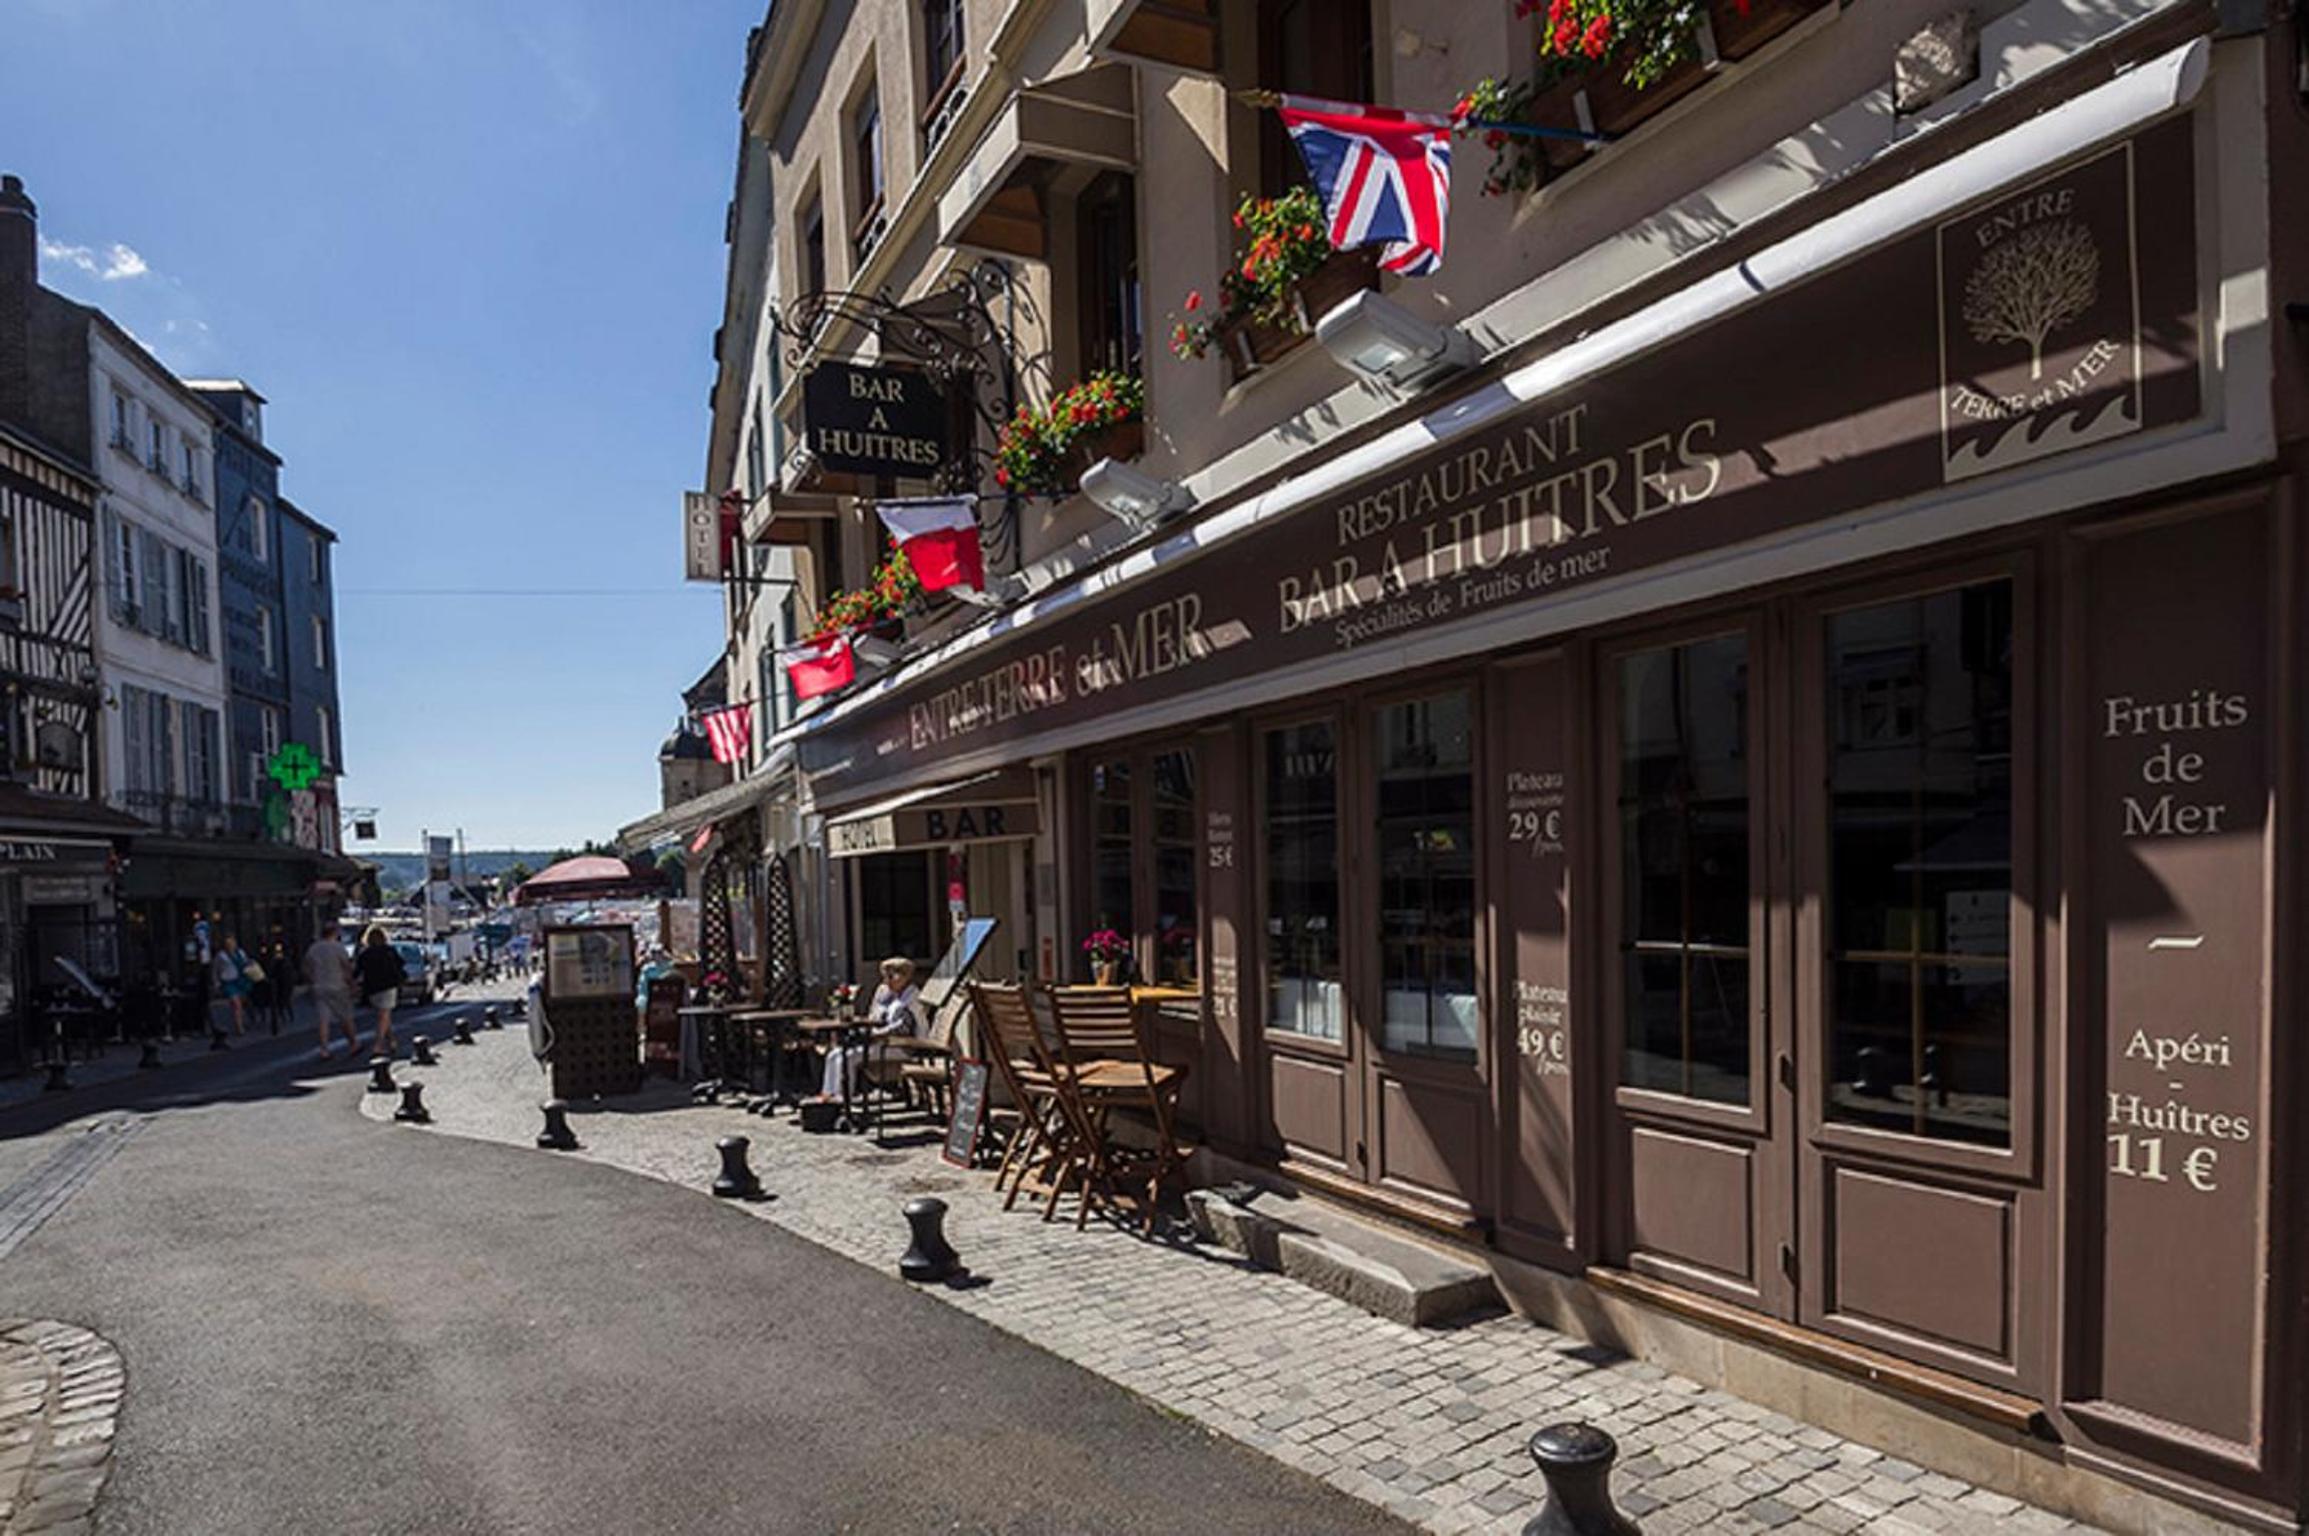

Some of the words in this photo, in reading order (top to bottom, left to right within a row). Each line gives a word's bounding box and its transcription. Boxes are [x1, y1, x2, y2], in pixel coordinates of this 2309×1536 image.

[1976, 188, 2076, 248] ENTRE
[850, 373, 904, 402] BAR
[1951, 385, 2027, 419] TERRE
[2031, 388, 2054, 411] et
[2055, 339, 2121, 399] MER
[868, 406, 889, 430] A
[818, 428, 940, 464] HUITRES
[1337, 404, 1588, 546] RESTAURANT
[1279, 556, 1362, 633] BAR
[1376, 539, 1409, 602] A
[1421, 419, 1722, 588] HUITRES
[1426, 589, 1452, 617] de
[1459, 569, 1523, 608] Fruits
[1526, 560, 1557, 588] de
[1560, 546, 1612, 581] mer
[910, 679, 977, 750] ENTRE
[978, 644, 1067, 727] TERRE
[1111, 592, 1213, 681] MER
[2105, 689, 2248, 737] Fruits
[2143, 742, 2204, 783] de
[927, 804, 1006, 839] BAR
[1508, 811, 1539, 839] 29
[2122, 794, 2226, 836] Mer
[1517, 1028, 1545, 1056] 49
[2125, 1029, 2231, 1070] Apéri
[2107, 1092, 2251, 1141] Huîtres
[2107, 1133, 2169, 1183] 11
[2182, 1147, 2218, 1191] €
